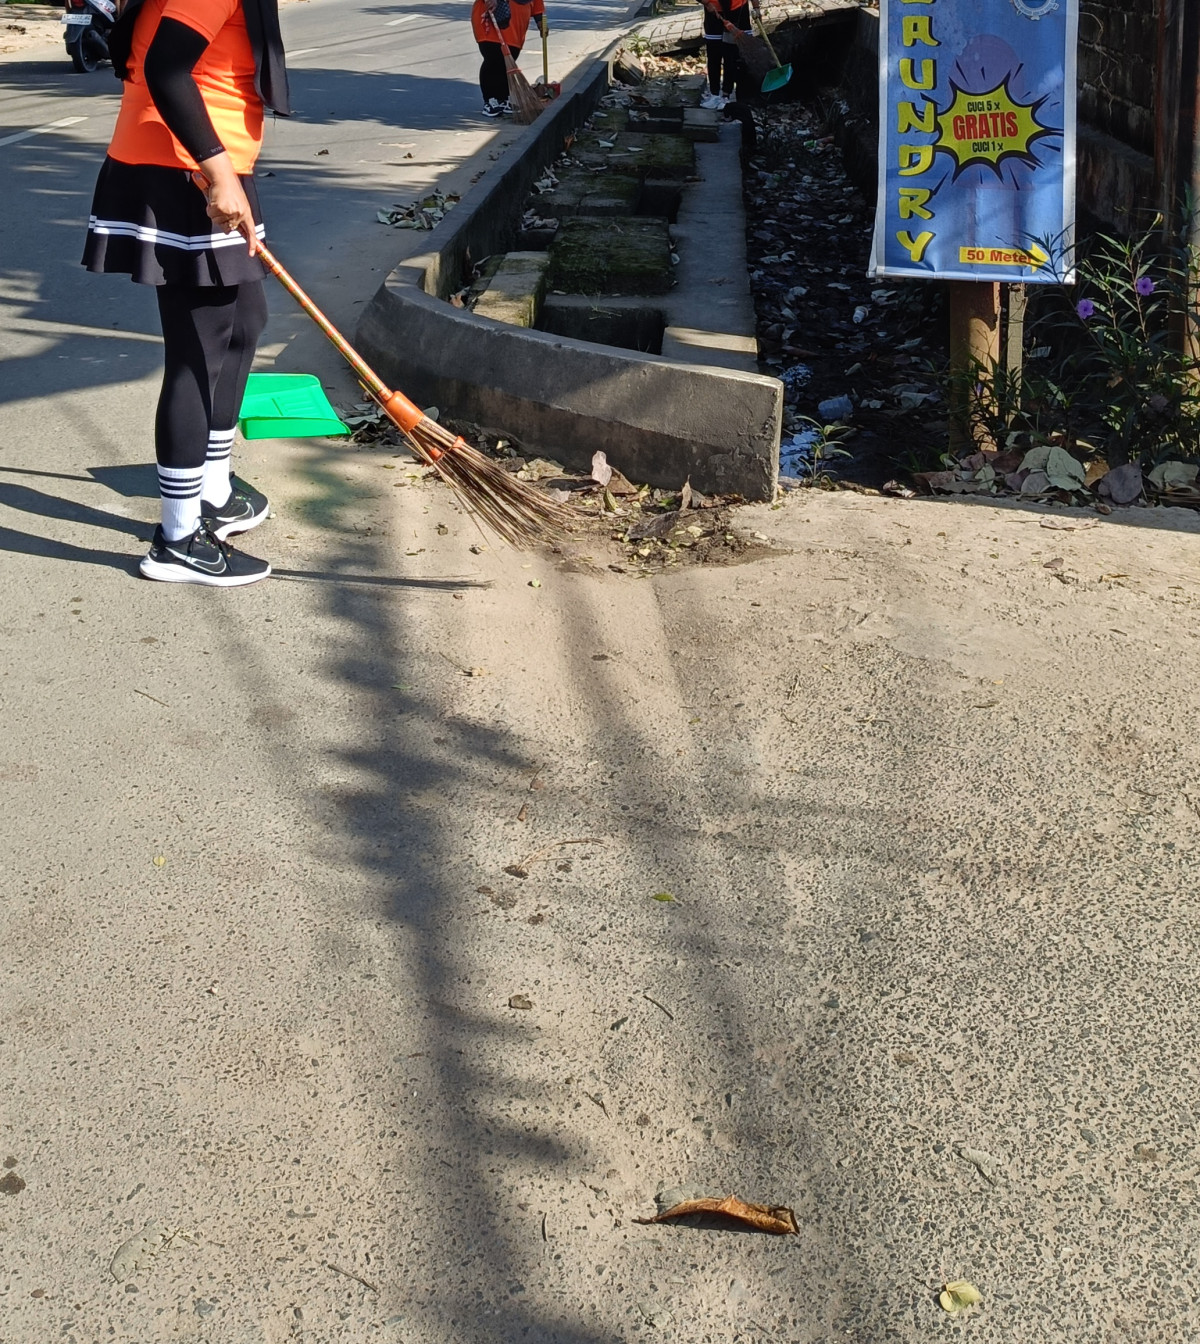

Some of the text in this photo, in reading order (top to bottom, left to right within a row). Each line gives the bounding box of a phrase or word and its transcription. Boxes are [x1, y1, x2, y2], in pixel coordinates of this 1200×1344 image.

[967, 101, 985, 113] CUCI
[986, 100, 993, 111] 5
[952, 111, 1019, 141] GRATIS
[972, 141, 990, 152] CUCI
[991, 141, 996, 151] 1
[967, 249, 985, 261] 50
